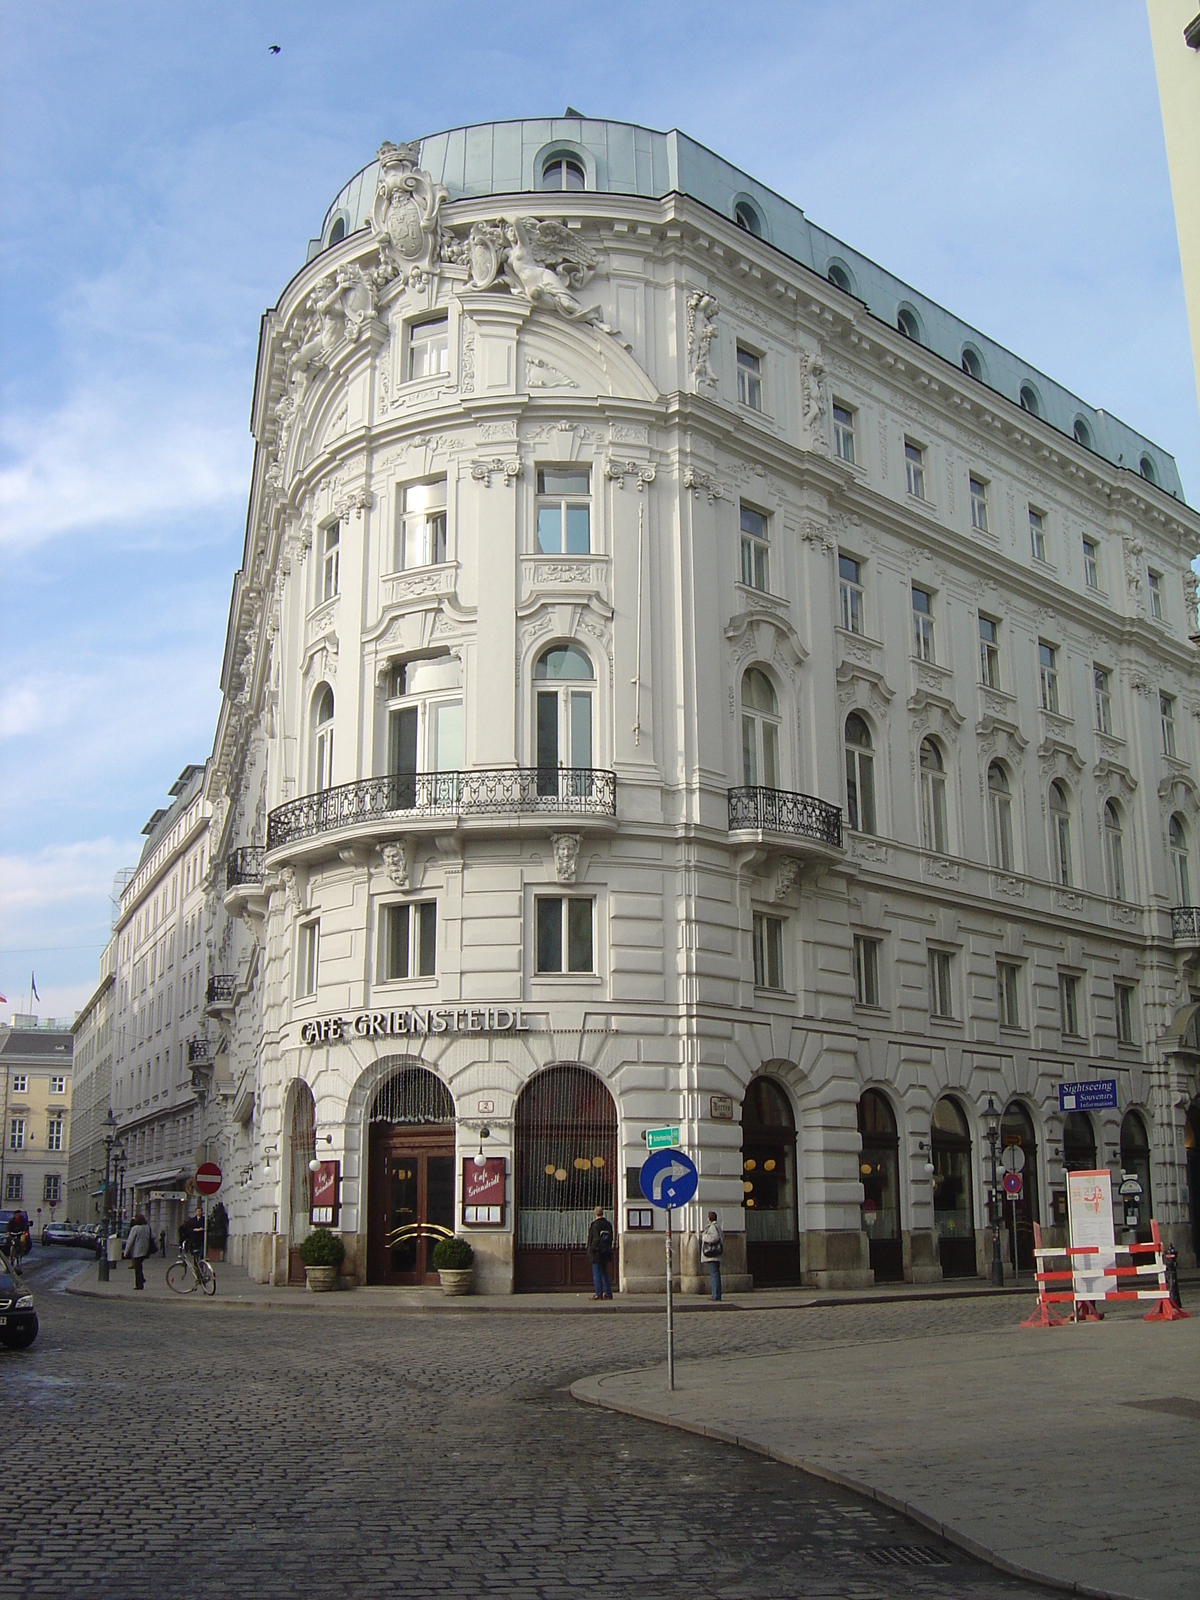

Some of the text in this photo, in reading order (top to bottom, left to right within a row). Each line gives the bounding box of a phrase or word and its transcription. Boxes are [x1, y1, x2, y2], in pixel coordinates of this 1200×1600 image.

[301, 1007, 530, 1044] CAFE GRIENSTEIDL
[1063, 1081, 1112, 1095] Sightseeing
[1080, 1092, 1113, 1101] Souvenirs
